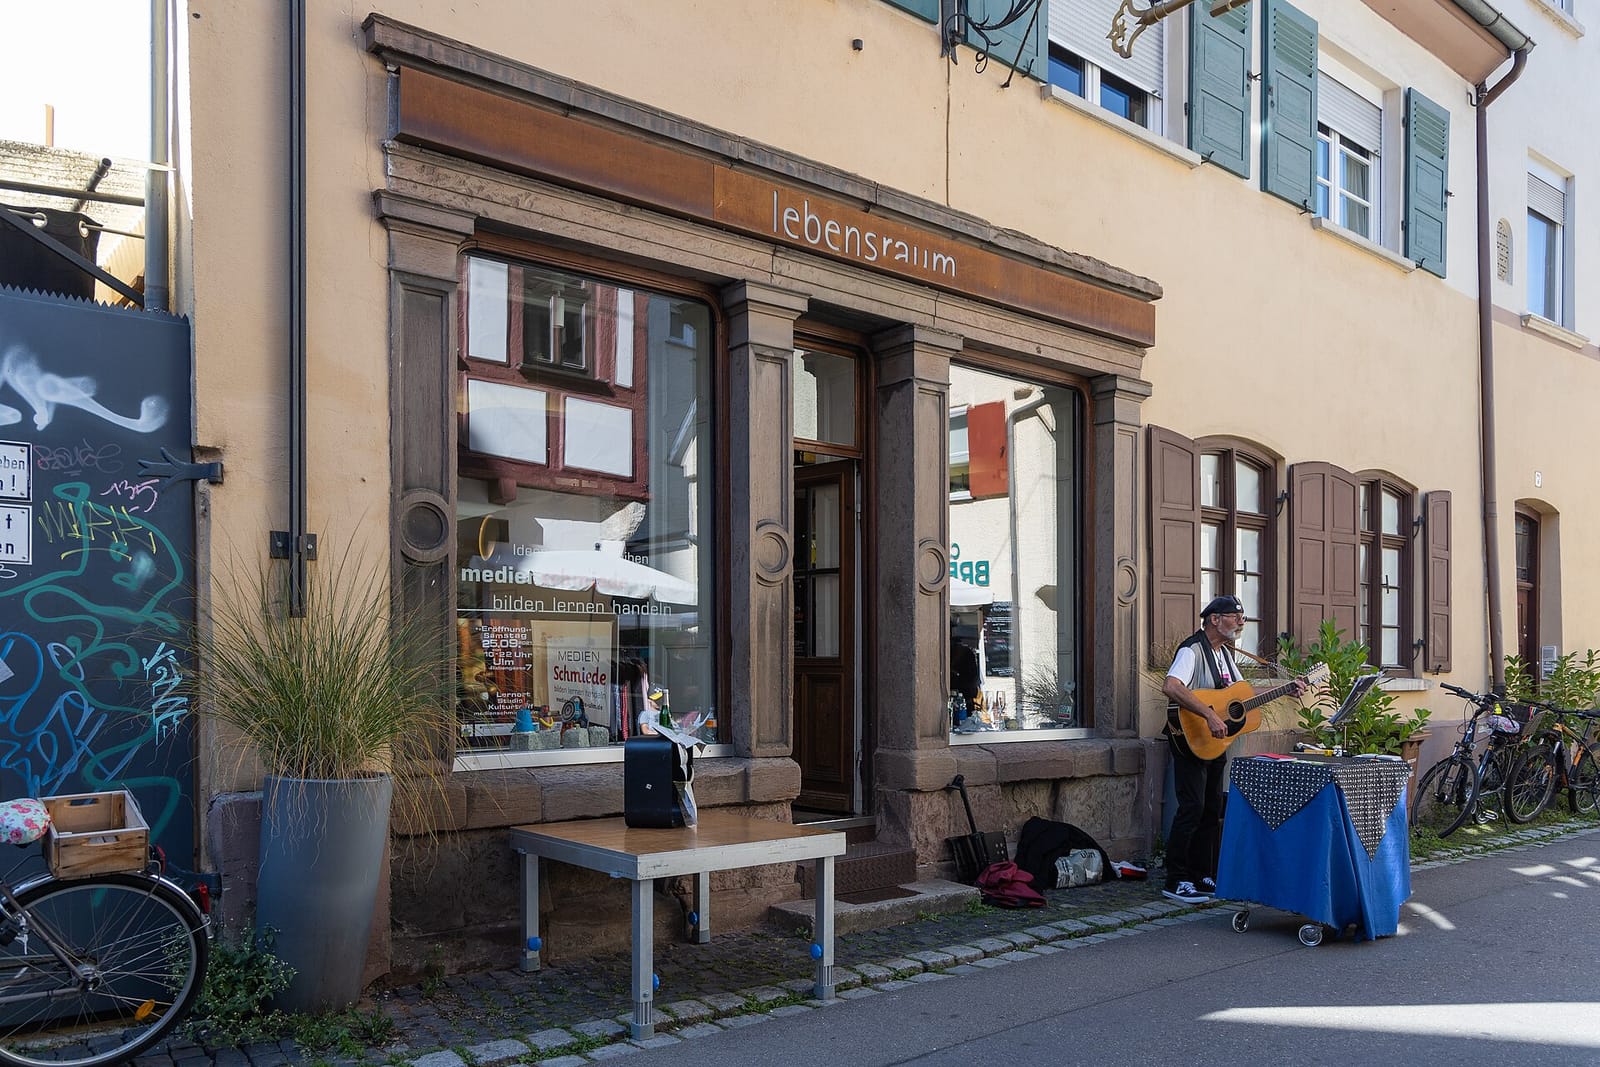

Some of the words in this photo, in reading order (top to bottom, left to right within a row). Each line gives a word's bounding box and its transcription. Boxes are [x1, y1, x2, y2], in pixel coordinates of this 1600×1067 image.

[493, 595, 544, 612] bilden
[553, 597, 605, 613] lernen
[612, 600, 672, 616] handeln
[493, 658, 514, 666] Ulm
[558, 650, 600, 662] MEDIEN
[553, 664, 607, 686] Schmiede
